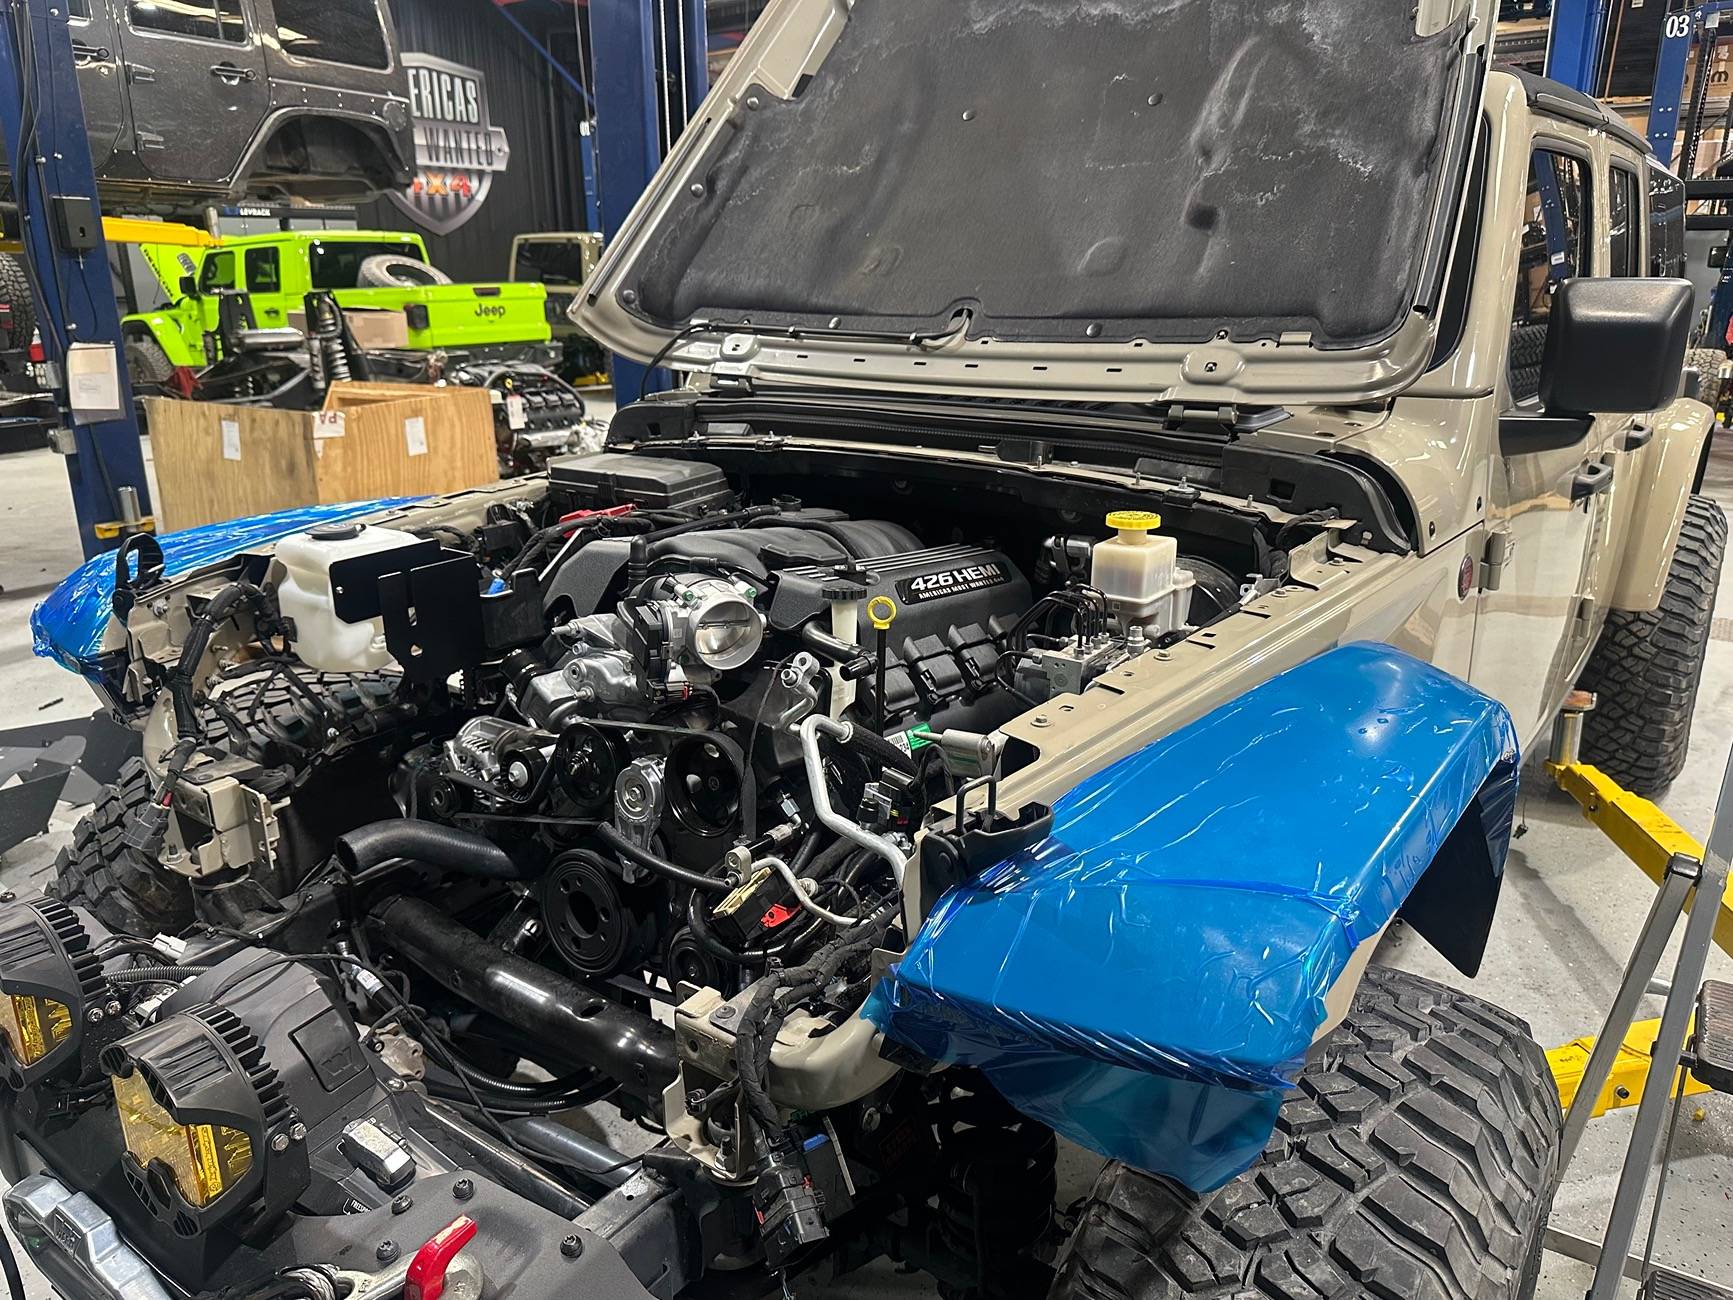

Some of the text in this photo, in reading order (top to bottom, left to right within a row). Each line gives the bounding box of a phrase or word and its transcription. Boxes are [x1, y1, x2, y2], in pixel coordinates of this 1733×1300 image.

[1666, 14, 1690, 38] 03
[423, 127, 494, 166] WANTED
[475, 303, 506, 319] Jeep
[911, 563, 1001, 591] 426 HEMI
